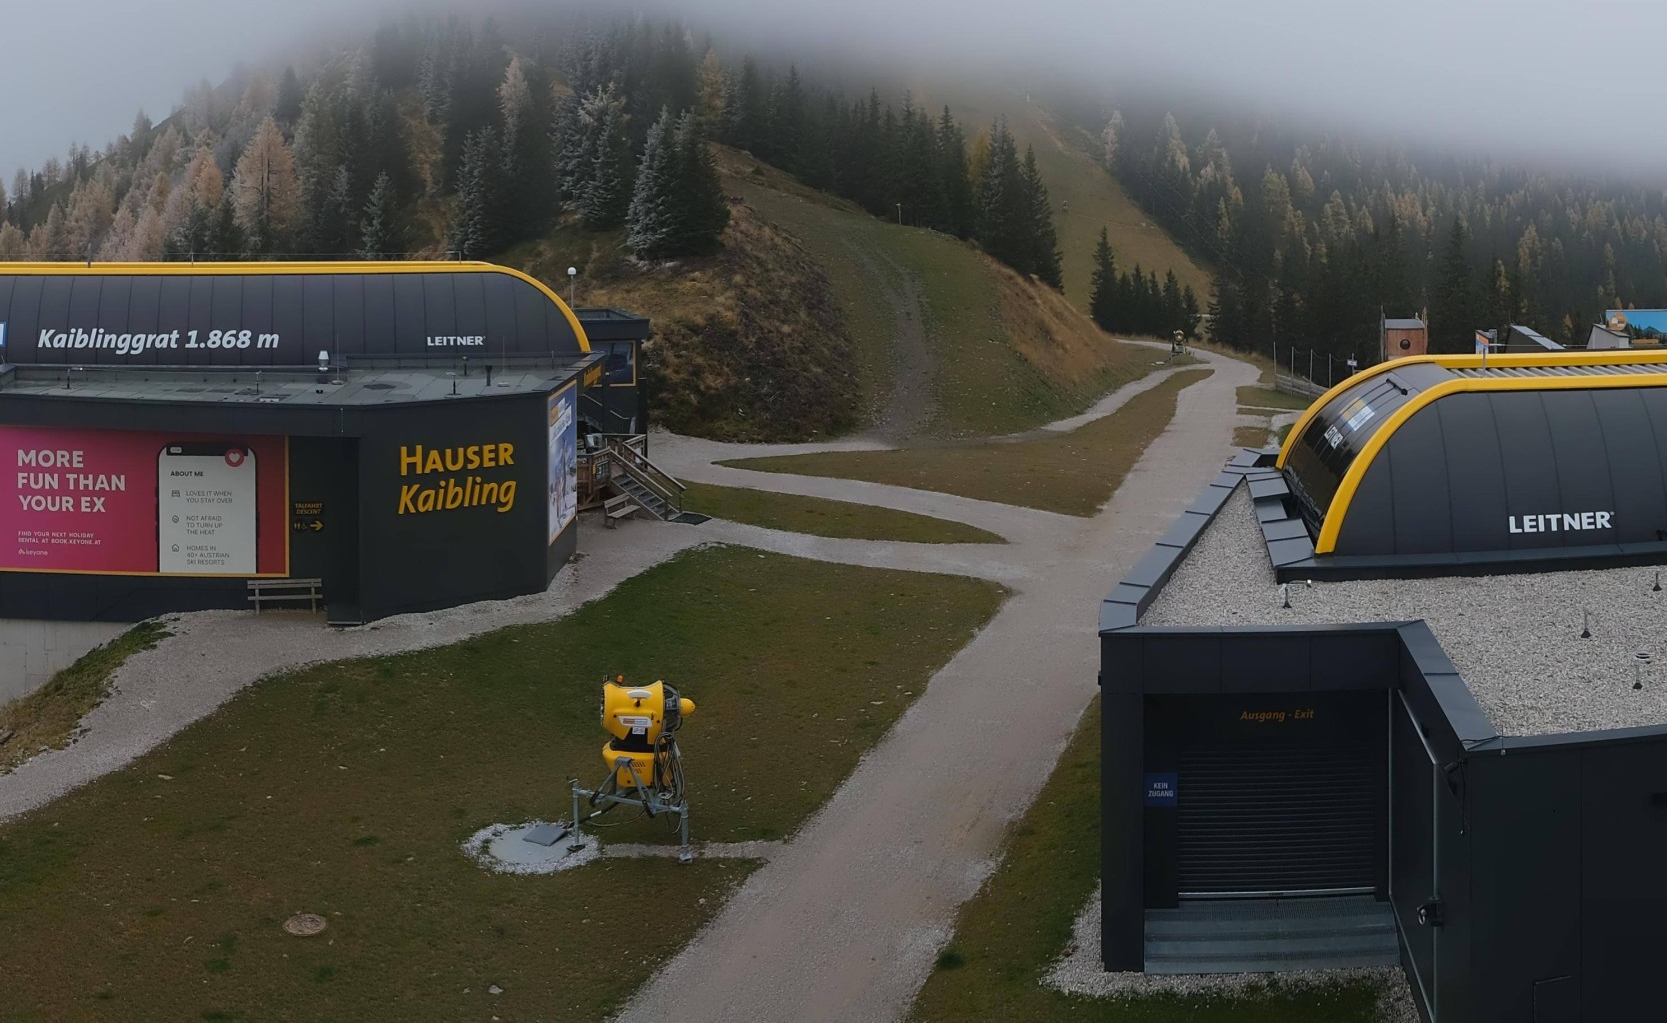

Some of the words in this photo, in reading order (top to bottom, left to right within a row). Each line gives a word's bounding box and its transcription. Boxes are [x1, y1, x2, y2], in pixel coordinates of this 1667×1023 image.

[37, 329, 180, 355] Kaiblinggrat
[185, 330, 252, 349] 1.868
[256, 333, 279, 348] m
[17, 449, 84, 468] MORE
[400, 442, 515, 476] HAUSER
[17, 473, 59, 490] FUN
[66, 473, 126, 491] THAN
[18, 495, 74, 512] YOUR
[81, 496, 106, 513] EX
[398, 476, 517, 515] Kaibling
[1240, 710, 1286, 723] Ausgang
[1294, 708, 1315, 719] Exit
